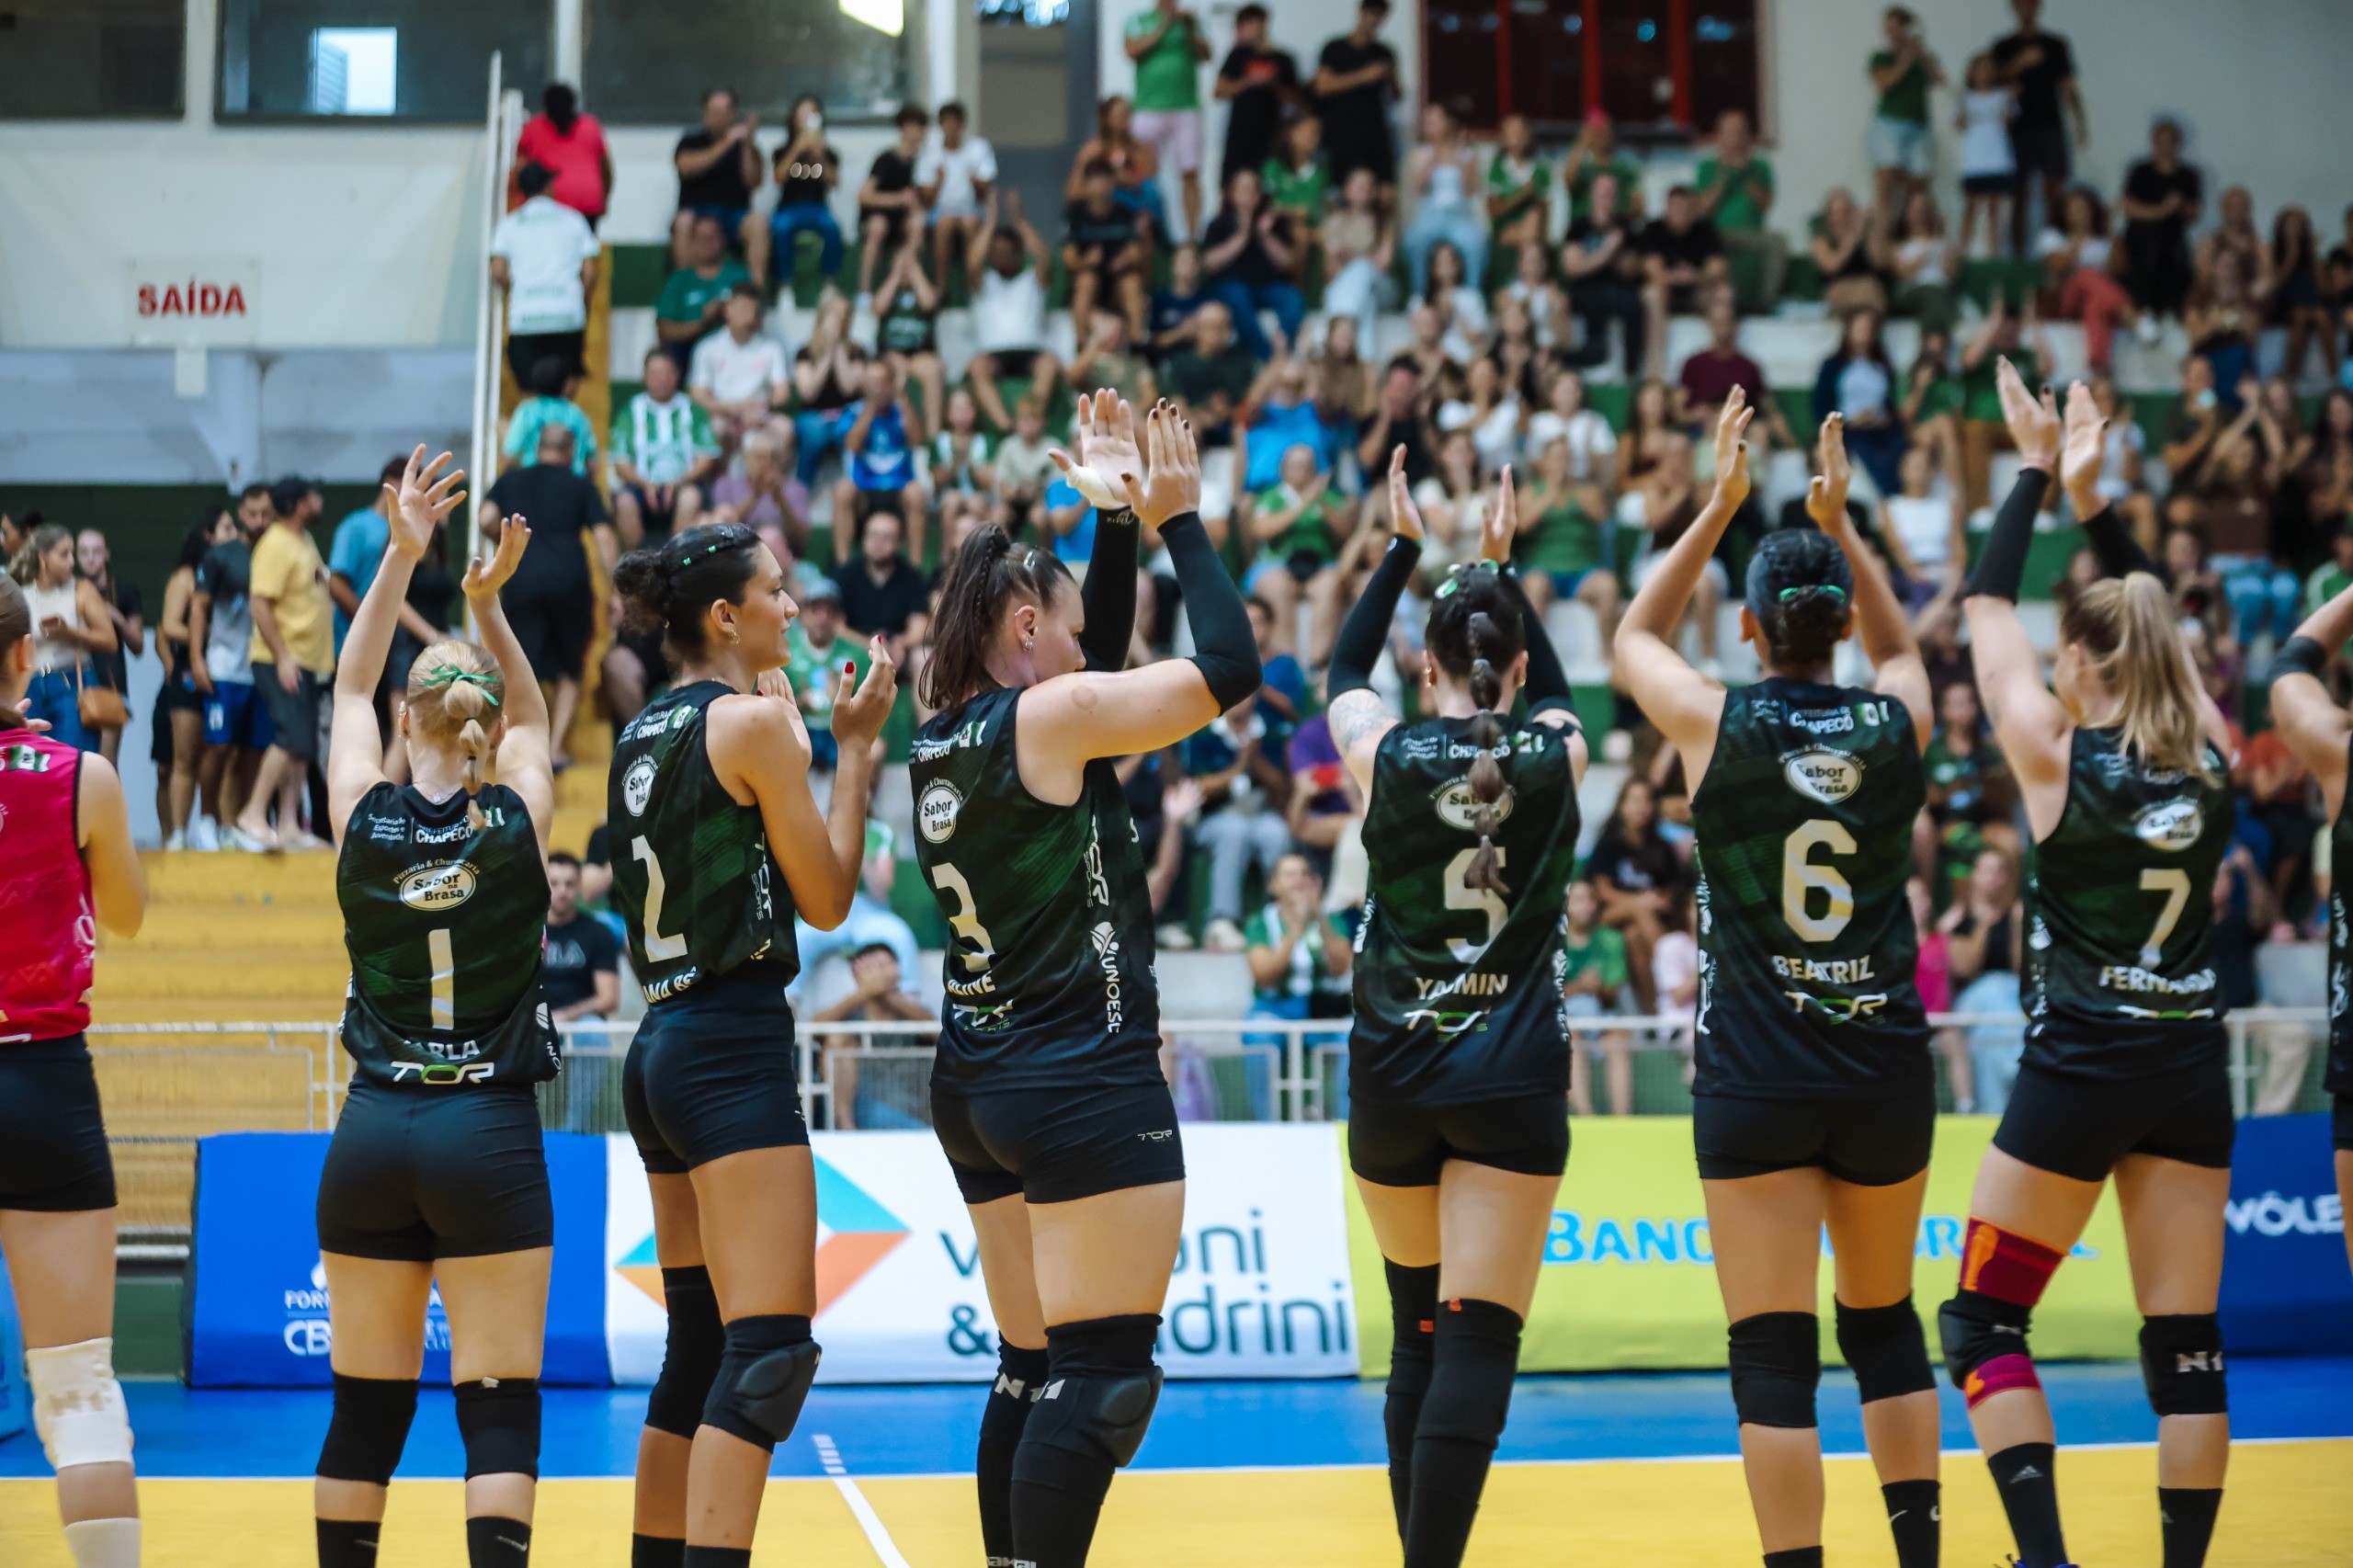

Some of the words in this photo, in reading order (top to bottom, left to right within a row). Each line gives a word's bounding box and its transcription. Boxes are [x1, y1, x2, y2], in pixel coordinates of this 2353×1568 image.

[138, 278, 247, 318] SAÍDA
[924, 800, 952, 817] Sabor
[931, 818, 952, 833] Brasa
[393, 863, 425, 884] Pizzaria
[426, 859, 433, 868] &
[414, 873, 460, 890] Sabor
[1782, 819, 1858, 942] 6
[425, 889, 464, 901] Brasa
[631, 835, 688, 963] 2
[1444, 846, 1509, 964] 5
[931, 862, 996, 972] 3
[2139, 869, 2191, 970] 7
[428, 928, 454, 1030] 1
[1416, 972, 1508, 1000] YAMIN
[1771, 955, 1875, 984] BEATRIZ
[391, 1061, 494, 1085] TOR
[948, 1305, 994, 1355] &
